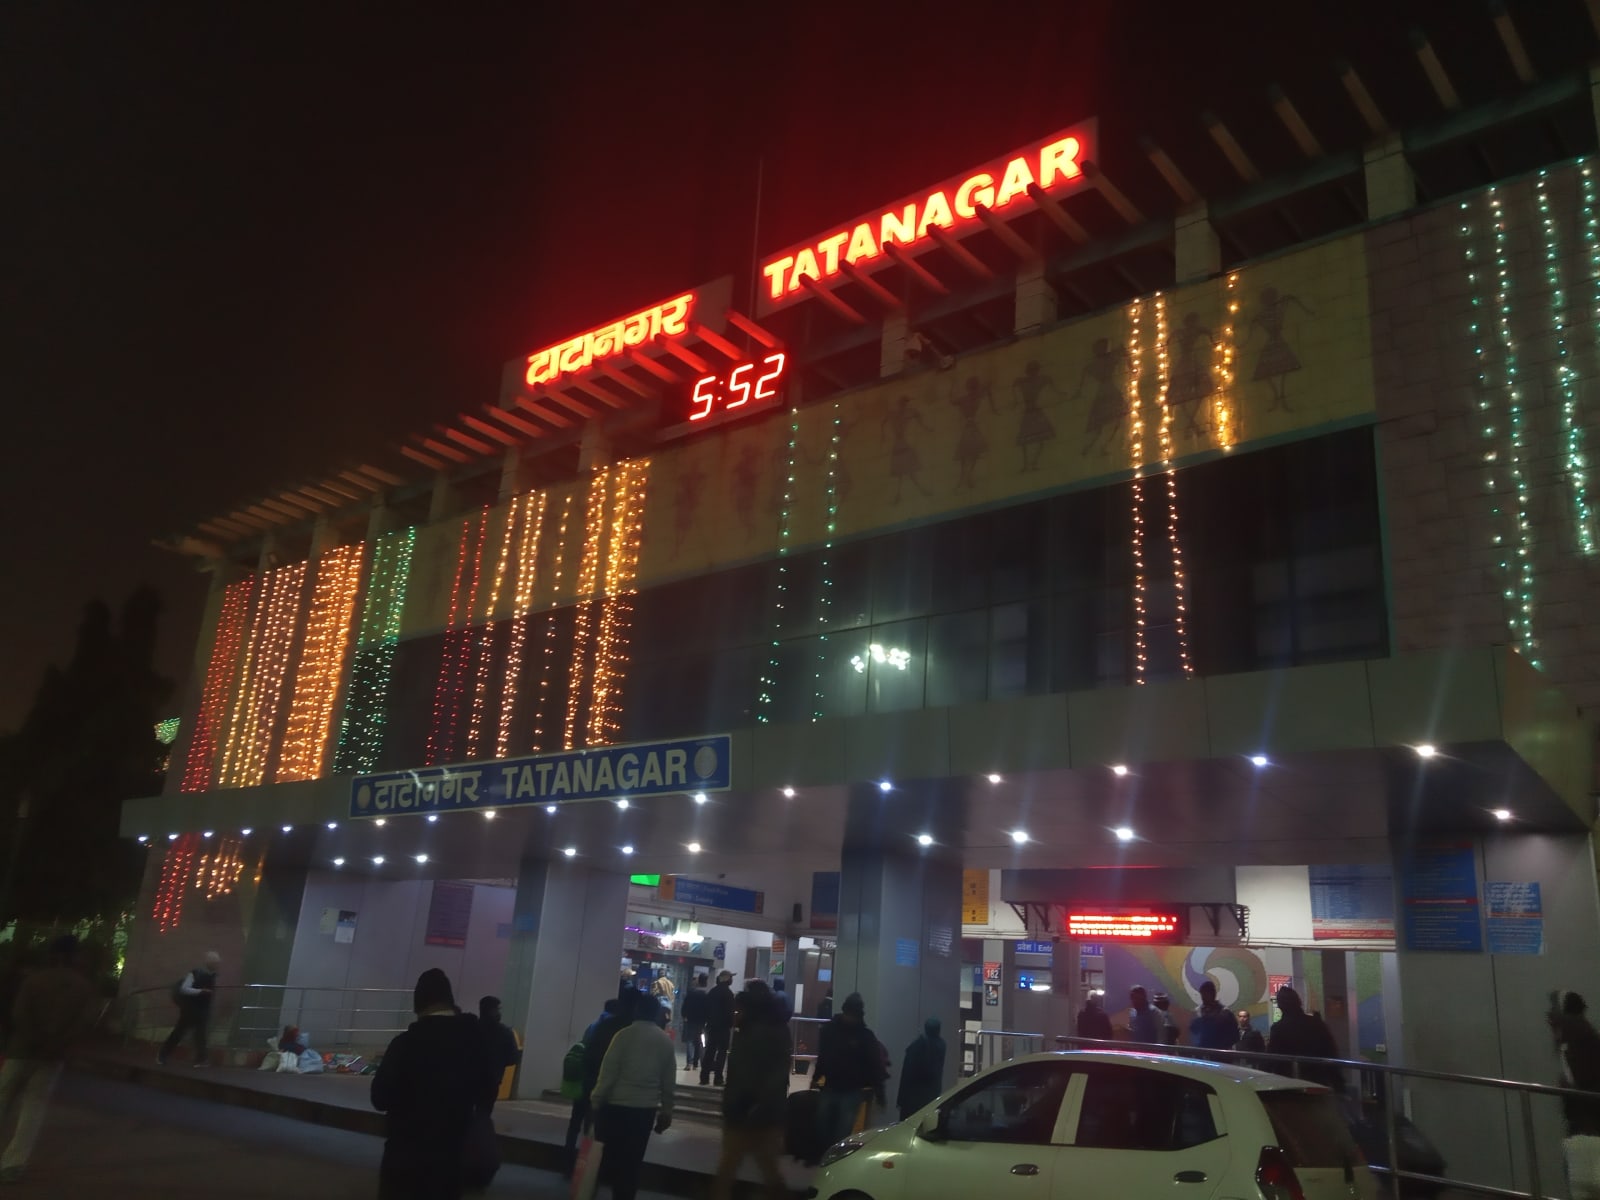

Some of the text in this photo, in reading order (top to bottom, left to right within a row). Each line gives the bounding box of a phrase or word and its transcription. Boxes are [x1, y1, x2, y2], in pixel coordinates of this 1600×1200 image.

[763, 136, 1081, 299] TATANAGAR
[526, 294, 693, 385] टाटानगर
[690, 353, 785, 420] 5:52
[374, 770, 482, 809] टाटानगर
[502, 749, 688, 799] TATANAGAR
[1038, 944, 1053, 952] Entr
[986, 969, 999, 979] 182
